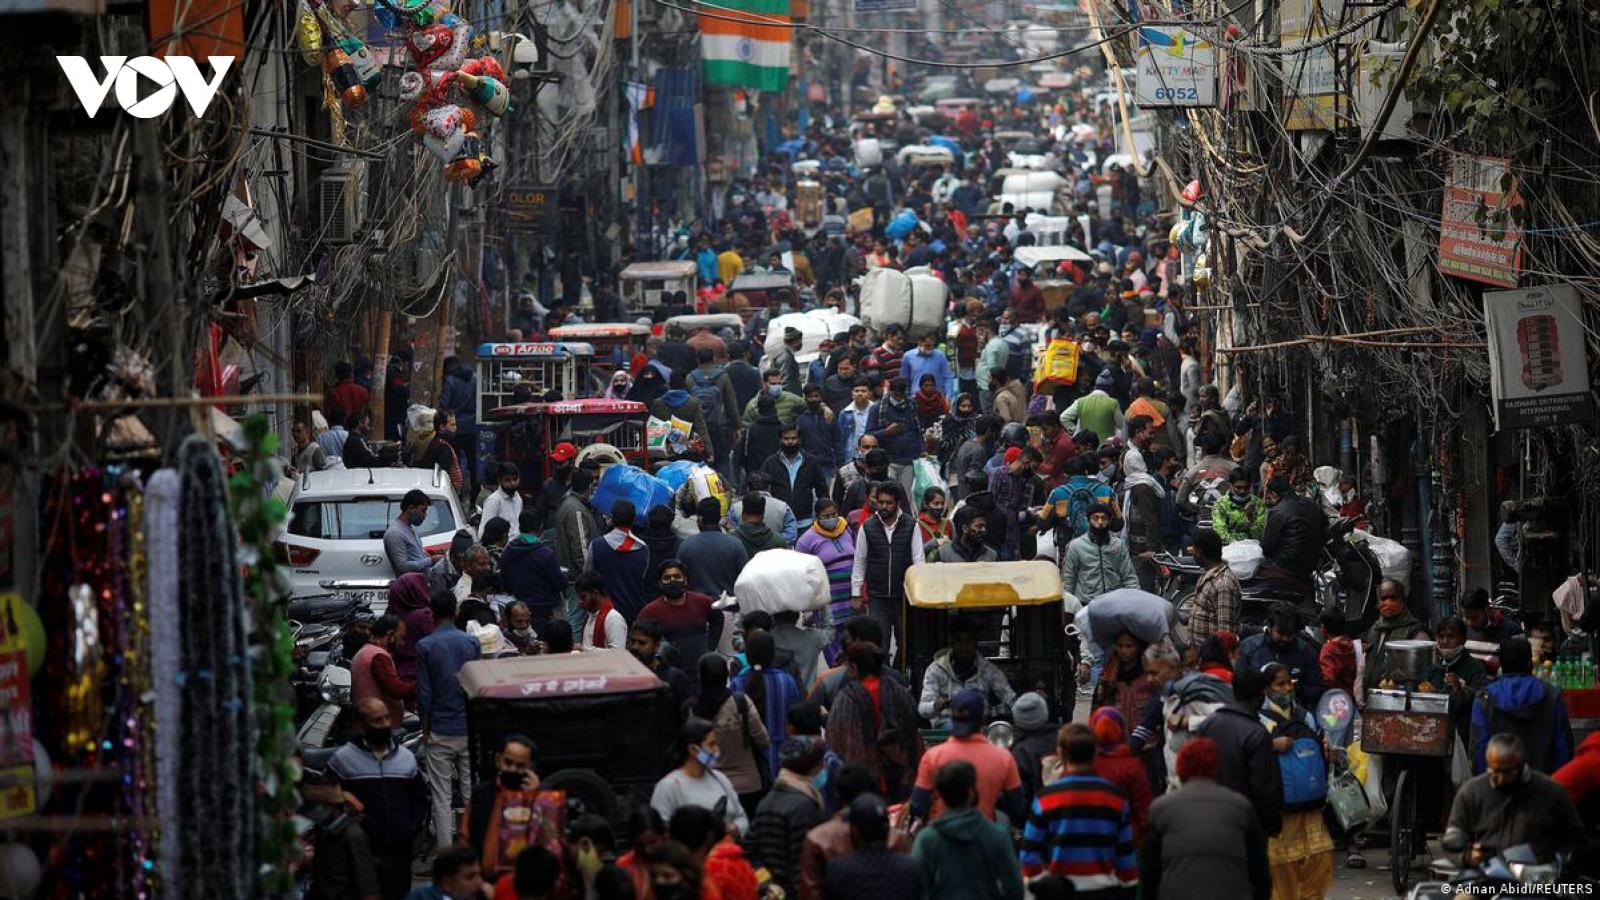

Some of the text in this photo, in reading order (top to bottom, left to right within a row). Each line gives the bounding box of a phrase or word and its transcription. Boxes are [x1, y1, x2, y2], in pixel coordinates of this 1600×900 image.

[1155, 88, 1196, 99] 6052
[509, 192, 545, 204] OLOR
[518, 344, 553, 353] Arzoo
